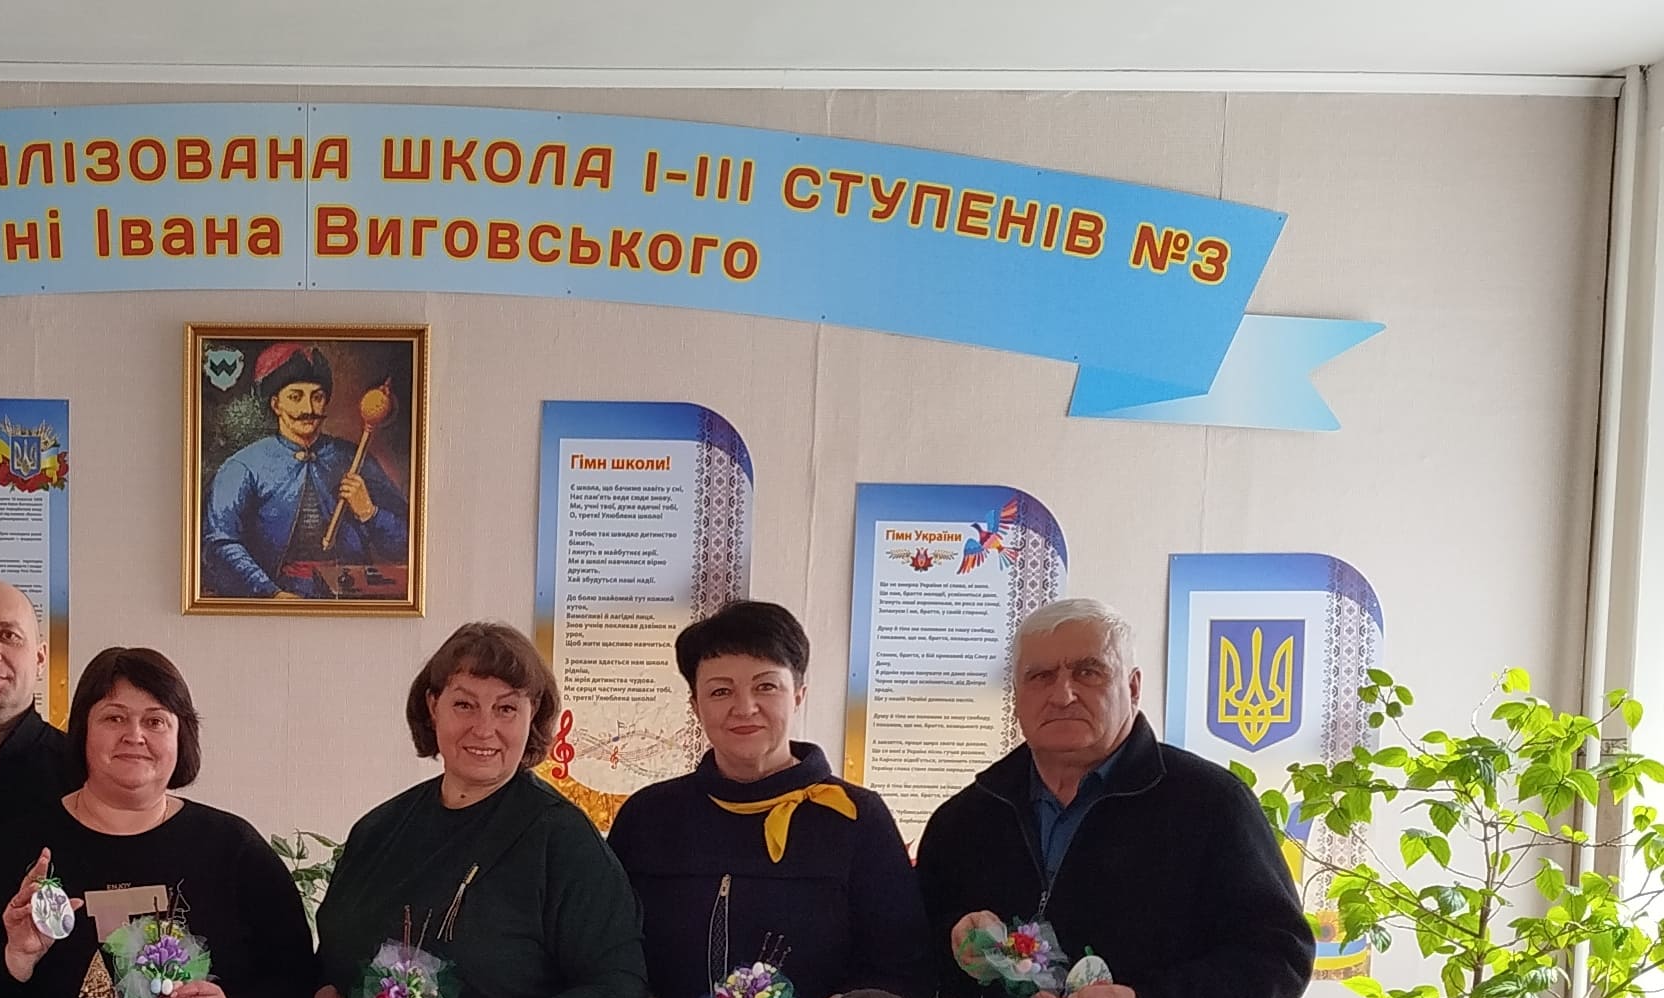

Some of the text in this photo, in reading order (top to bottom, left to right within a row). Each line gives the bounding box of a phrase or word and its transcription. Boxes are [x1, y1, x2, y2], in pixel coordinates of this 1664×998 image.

[382, 137, 613, 190] ШКОЛА
[783, 166, 1105, 256] СТУПЕНІВ
[1131, 224, 1229, 283] №3
[94, 207, 283, 259] Івана
[314, 204, 760, 282] Виговського
[571, 455, 671, 471] Гімн школи!
[886, 530, 962, 543] Гімн України
